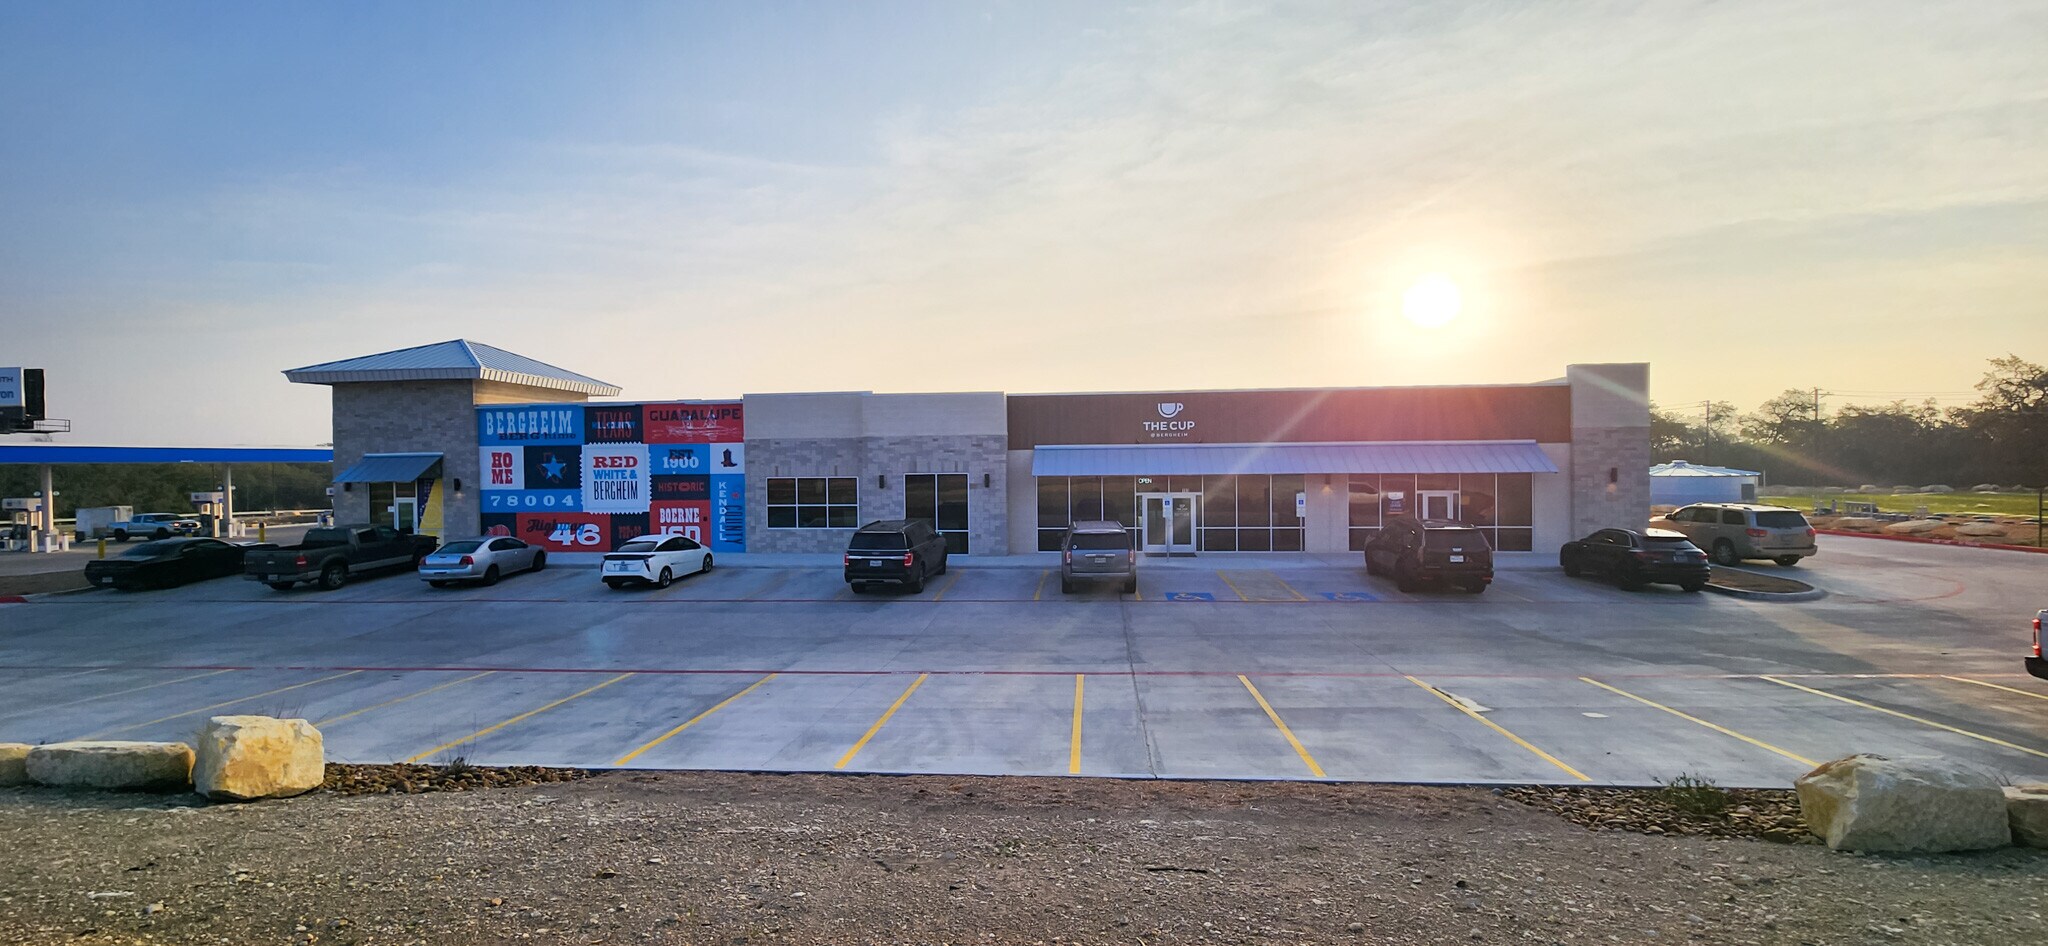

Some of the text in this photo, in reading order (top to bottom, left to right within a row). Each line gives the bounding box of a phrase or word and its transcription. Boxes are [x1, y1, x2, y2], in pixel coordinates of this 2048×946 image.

[649, 408, 742, 421] GUADALUPE
[486, 410, 572, 435] BERGHEIM
[595, 411, 632, 438] TEXAS
[1143, 421, 1195, 431] THE CUP
[491, 452, 513, 468] HO
[593, 456, 638, 468] RED
[662, 456, 699, 468] 1900
[669, 449, 693, 460] EST
[491, 469, 513, 484] ME
[593, 469, 638, 479] WHITE &
[593, 480, 638, 500] BERGHEIM
[658, 481, 705, 492] HISTORIC
[490, 495, 574, 506] 78004
[660, 507, 700, 523] BOERNE
[719, 481, 727, 540] KENDALL
[526, 518, 585, 535] Highway
[548, 523, 600, 545] 46
